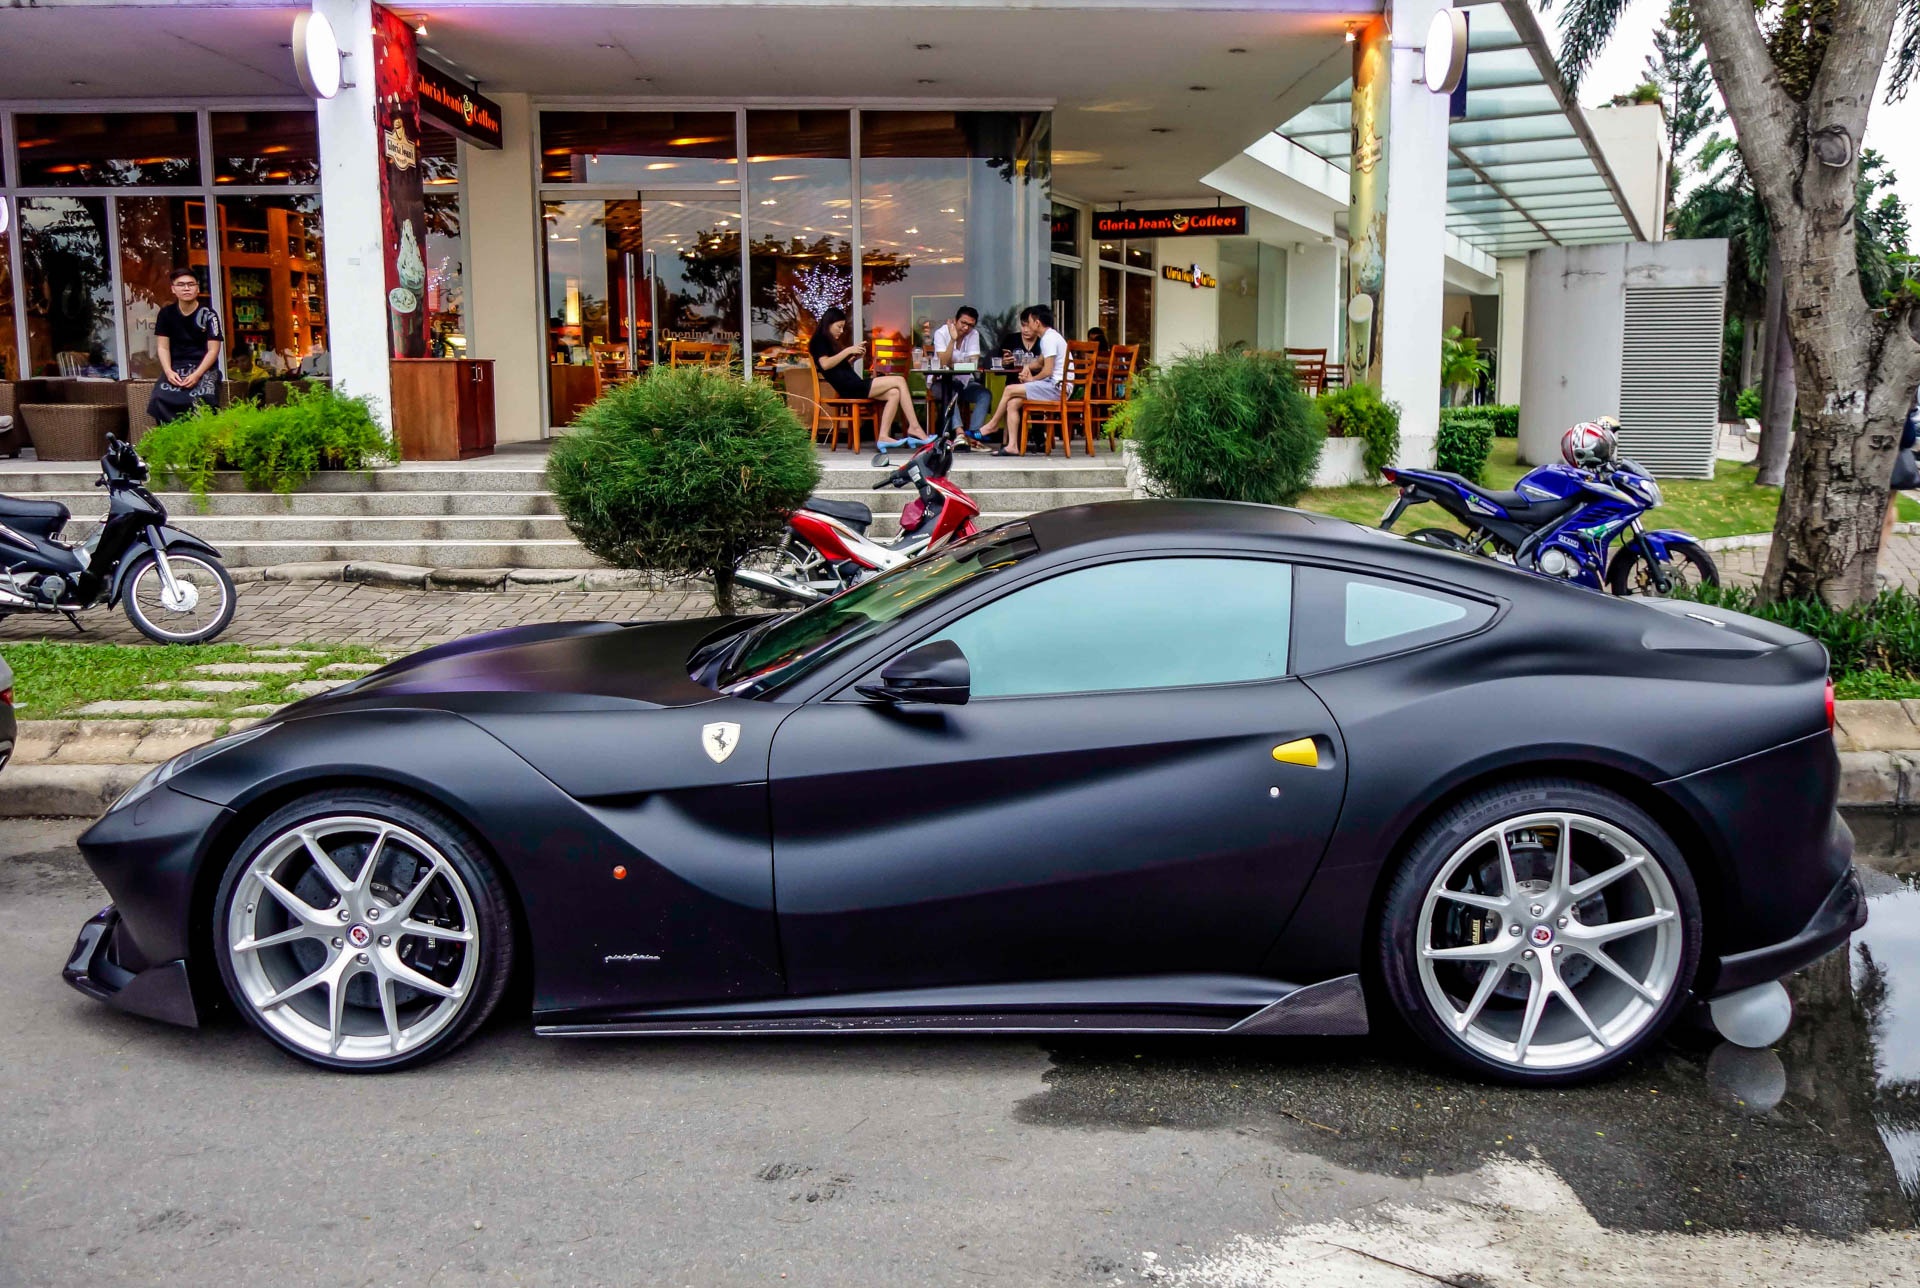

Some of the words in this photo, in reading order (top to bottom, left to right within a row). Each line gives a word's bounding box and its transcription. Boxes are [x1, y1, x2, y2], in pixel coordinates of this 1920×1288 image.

[1099, 218, 1136, 232] Gloria
[1138, 217, 1171, 230] Jean's
[1190, 214, 1237, 228] Coffees
